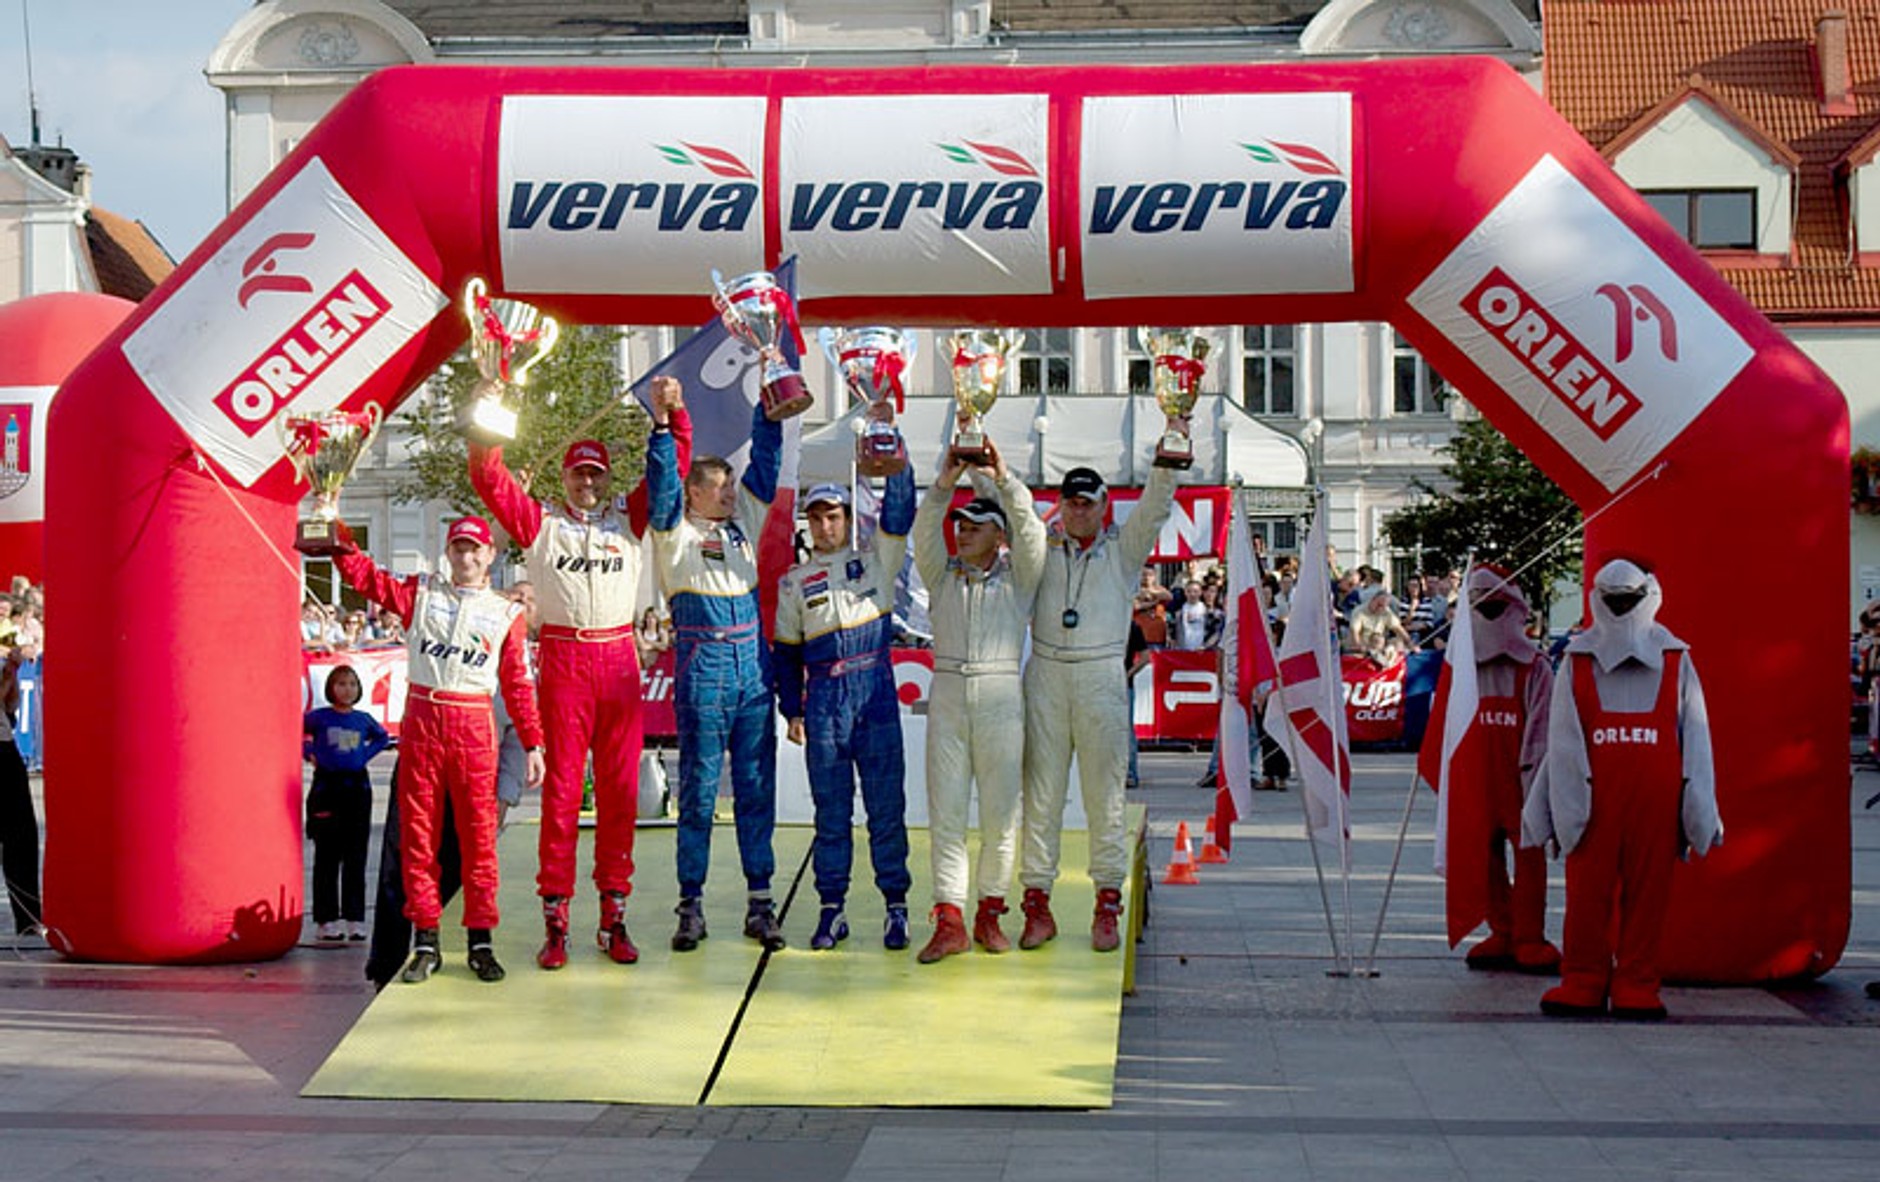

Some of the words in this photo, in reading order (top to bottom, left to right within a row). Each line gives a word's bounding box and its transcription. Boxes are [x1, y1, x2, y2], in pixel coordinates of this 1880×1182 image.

[508, 181, 758, 231] verva
[790, 181, 1042, 232] verva
[1089, 180, 1347, 234] verva
[231, 282, 380, 421] ORLEN
[1478, 286, 1627, 429] ORLEN
[1593, 727, 1658, 745] ORLEN
